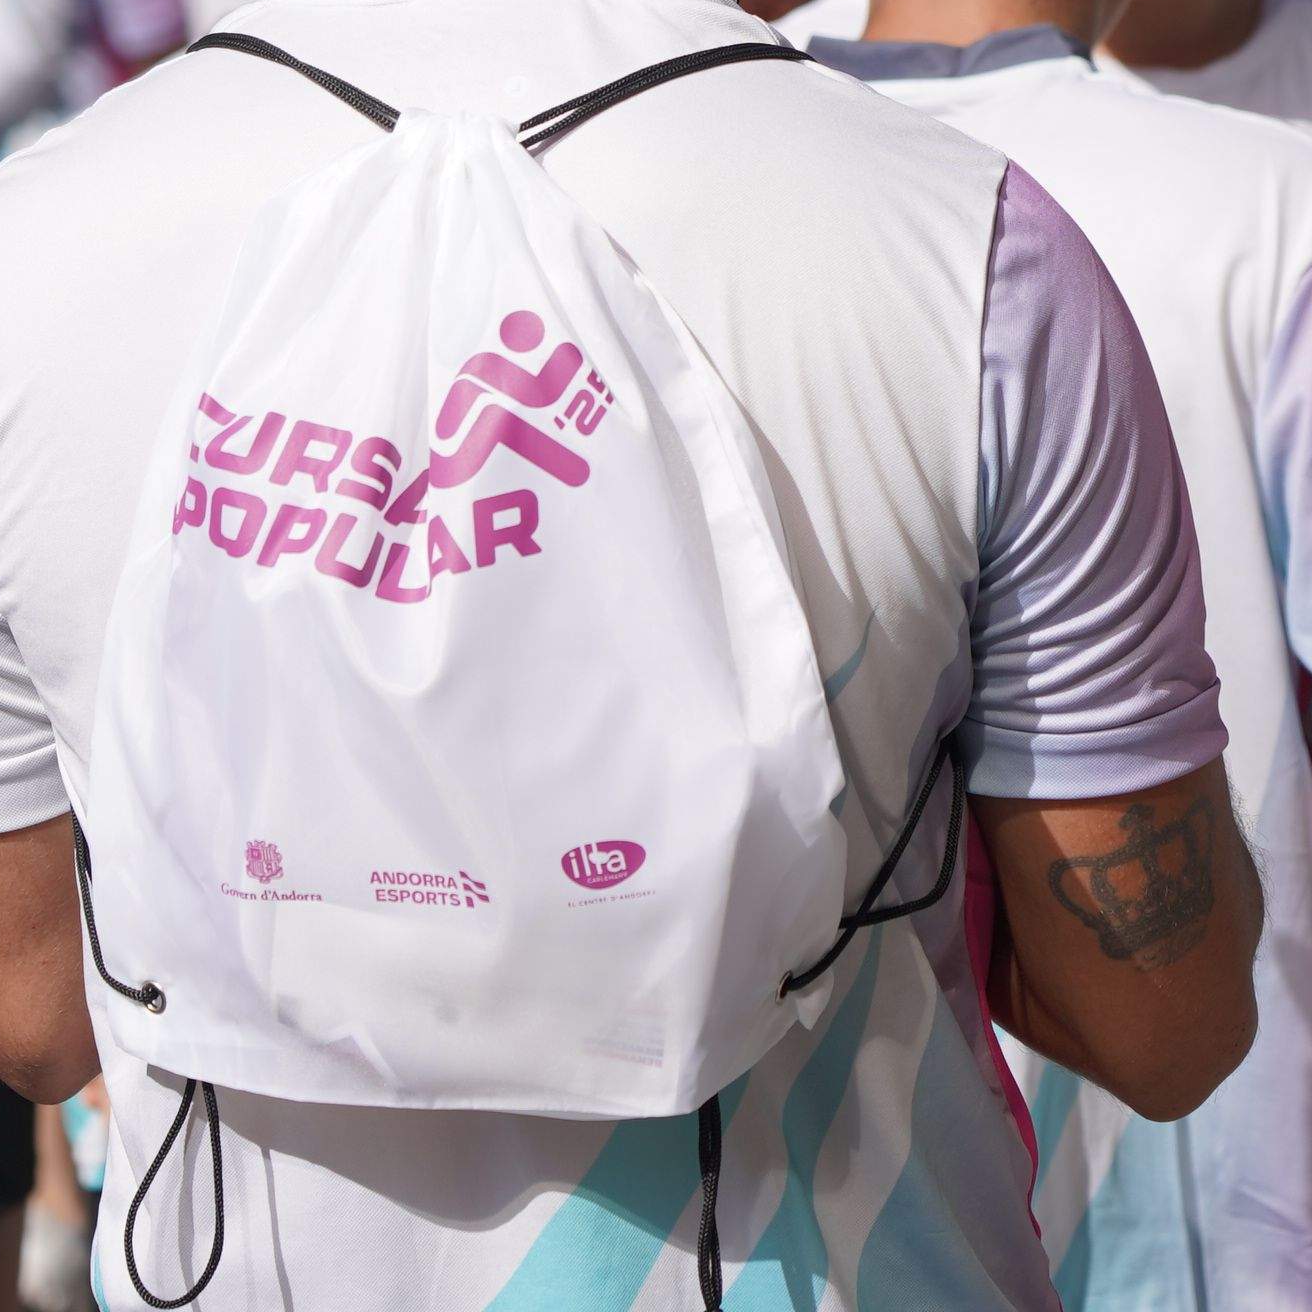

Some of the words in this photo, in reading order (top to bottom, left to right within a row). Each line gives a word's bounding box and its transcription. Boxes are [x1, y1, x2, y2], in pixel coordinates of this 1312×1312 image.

[172, 475, 543, 604] POPULAR
[370, 871, 458, 890] ANDORRA
[221, 882, 257, 901] Govern
[260, 889, 323, 902] d'Andorra
[375, 889, 461, 907] ESPORTS
